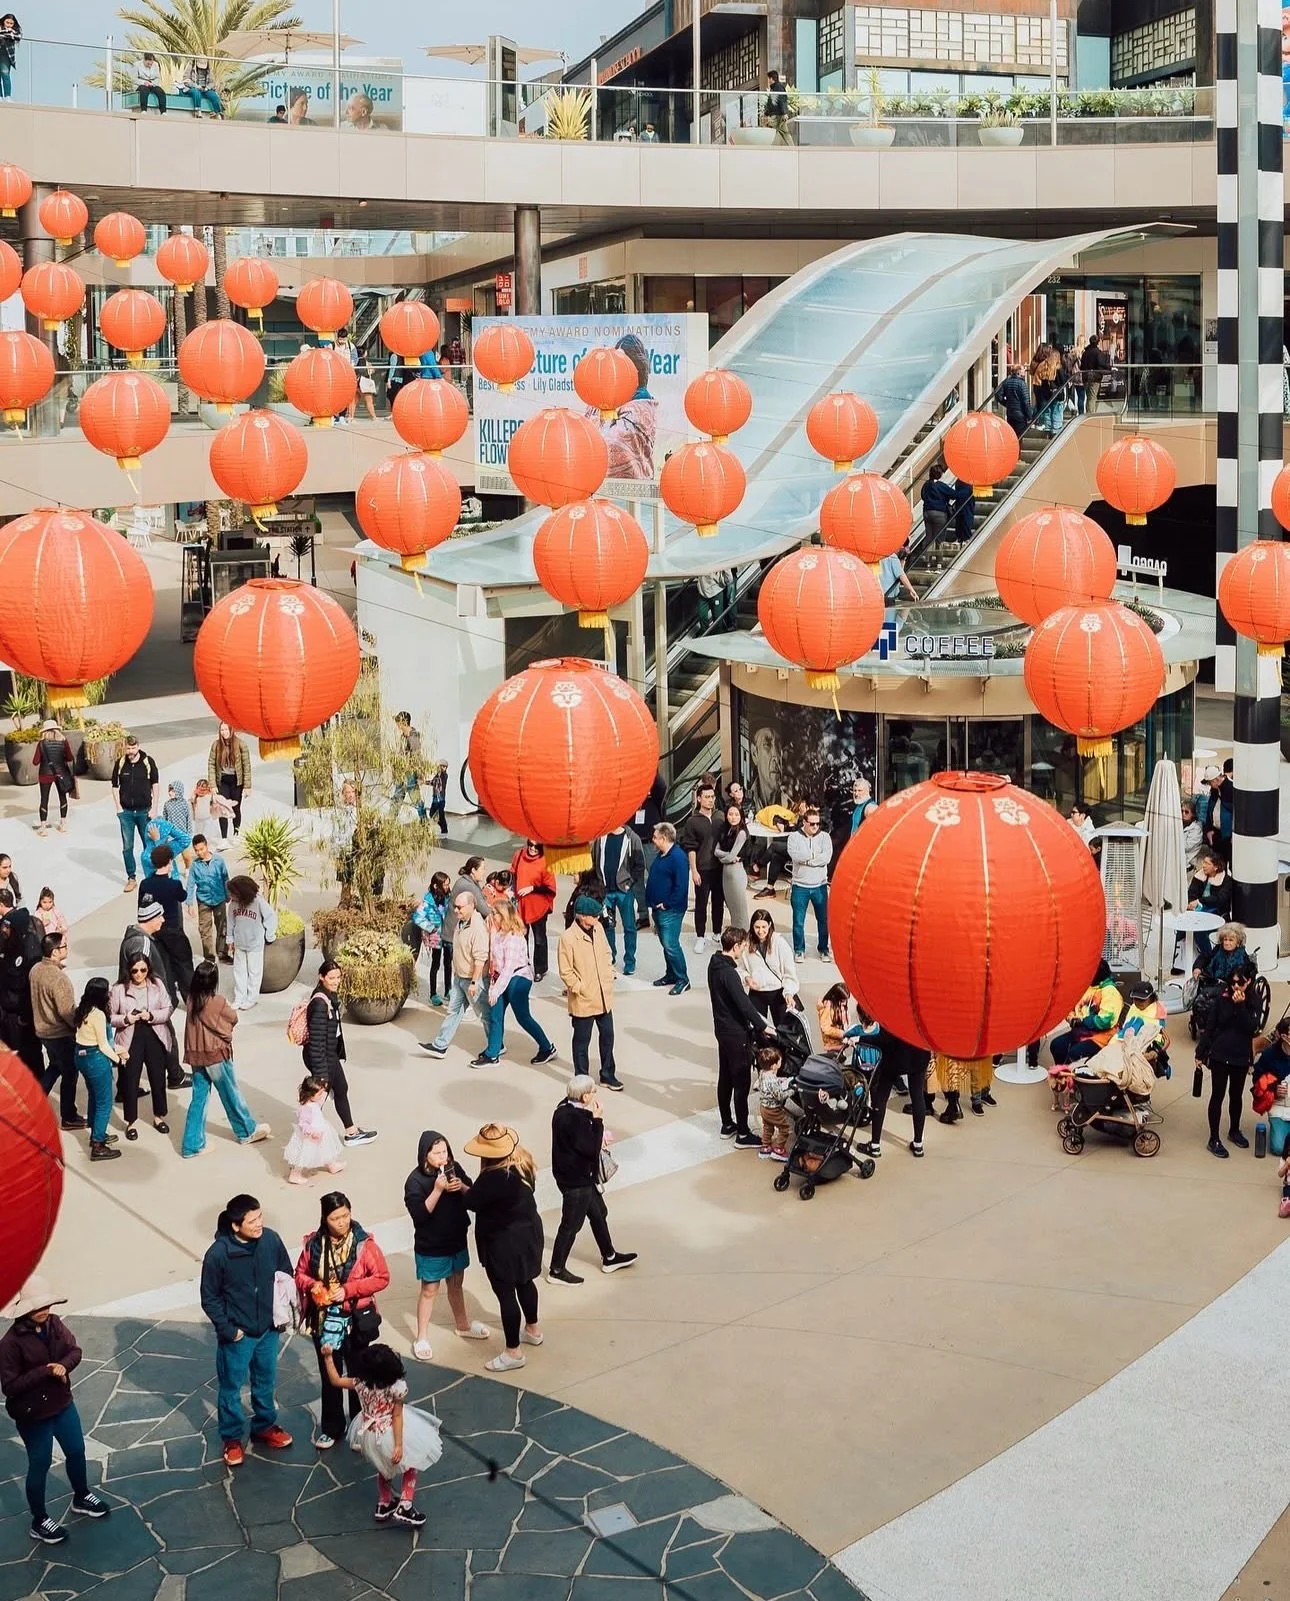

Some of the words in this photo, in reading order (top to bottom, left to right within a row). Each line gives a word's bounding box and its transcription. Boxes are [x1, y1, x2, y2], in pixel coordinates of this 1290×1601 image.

[262, 81, 312, 99] Picte
[317, 82, 331, 100] of
[336, 83, 358, 100] he
[363, 83, 393, 101] Year
[1047, 276, 1061, 284] 232
[548, 325, 589, 337] AWARD
[594, 325, 681, 337] NOMINATIONS
[530, 350, 567, 374] ture
[533, 377, 547, 393] Lily
[548, 377, 574, 391] Gladst
[479, 443, 509, 464] FLOW
[905, 635, 995, 656] COFFEE
[232, 908, 257, 920] ARVARD
